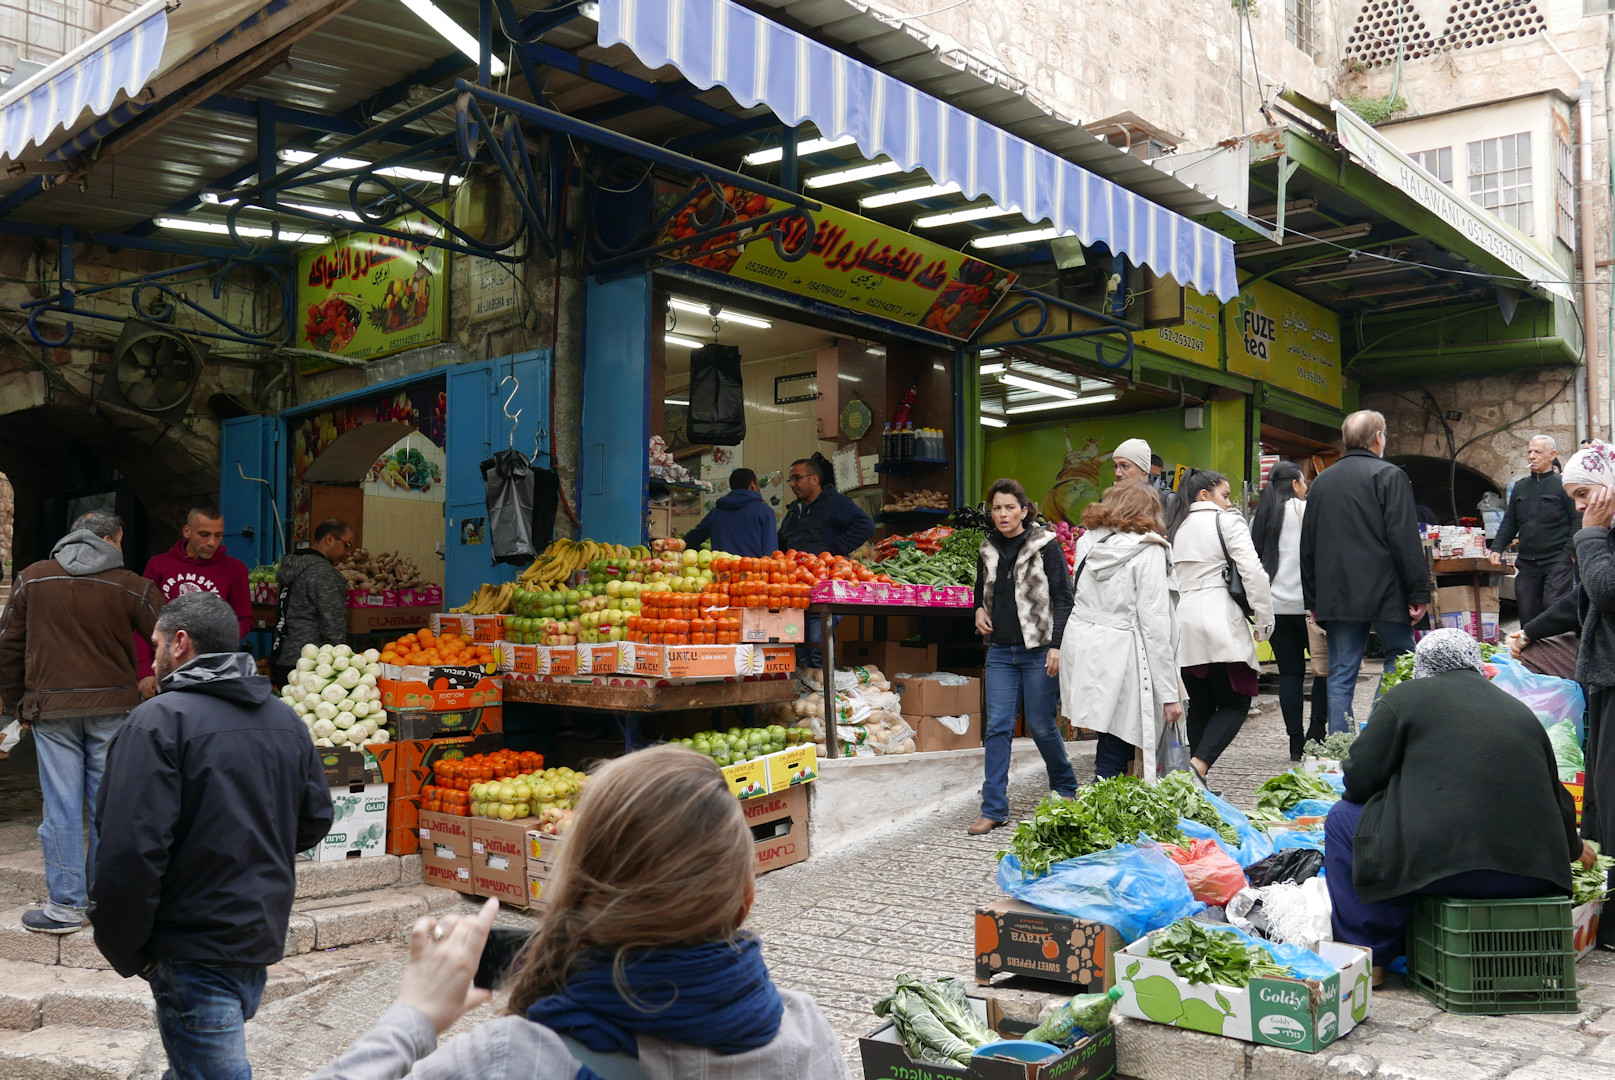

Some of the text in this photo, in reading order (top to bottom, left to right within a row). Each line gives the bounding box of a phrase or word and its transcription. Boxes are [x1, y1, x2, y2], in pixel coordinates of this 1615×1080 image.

[1399, 166, 1525, 273] HALAWANI 052-2532242
[1244, 310, 1276, 342] FUZE
[1159, 327, 1205, 352] 052-2532242
[1243, 333, 1267, 360] tea
[162, 573, 222, 600] ABRAMSKY
[593, 664, 612, 672] חצבה
[636, 663, 658, 672] חצבה
[766, 663, 790, 672] חצבה
[1010, 931, 1052, 948] Arava
[1006, 956, 1061, 973] SWEET PEPPERS
[1259, 987, 1303, 1010] Goldy
[1270, 1016, 1291, 1026] Goldy
[1281, 1029, 1301, 1039] גולדי
